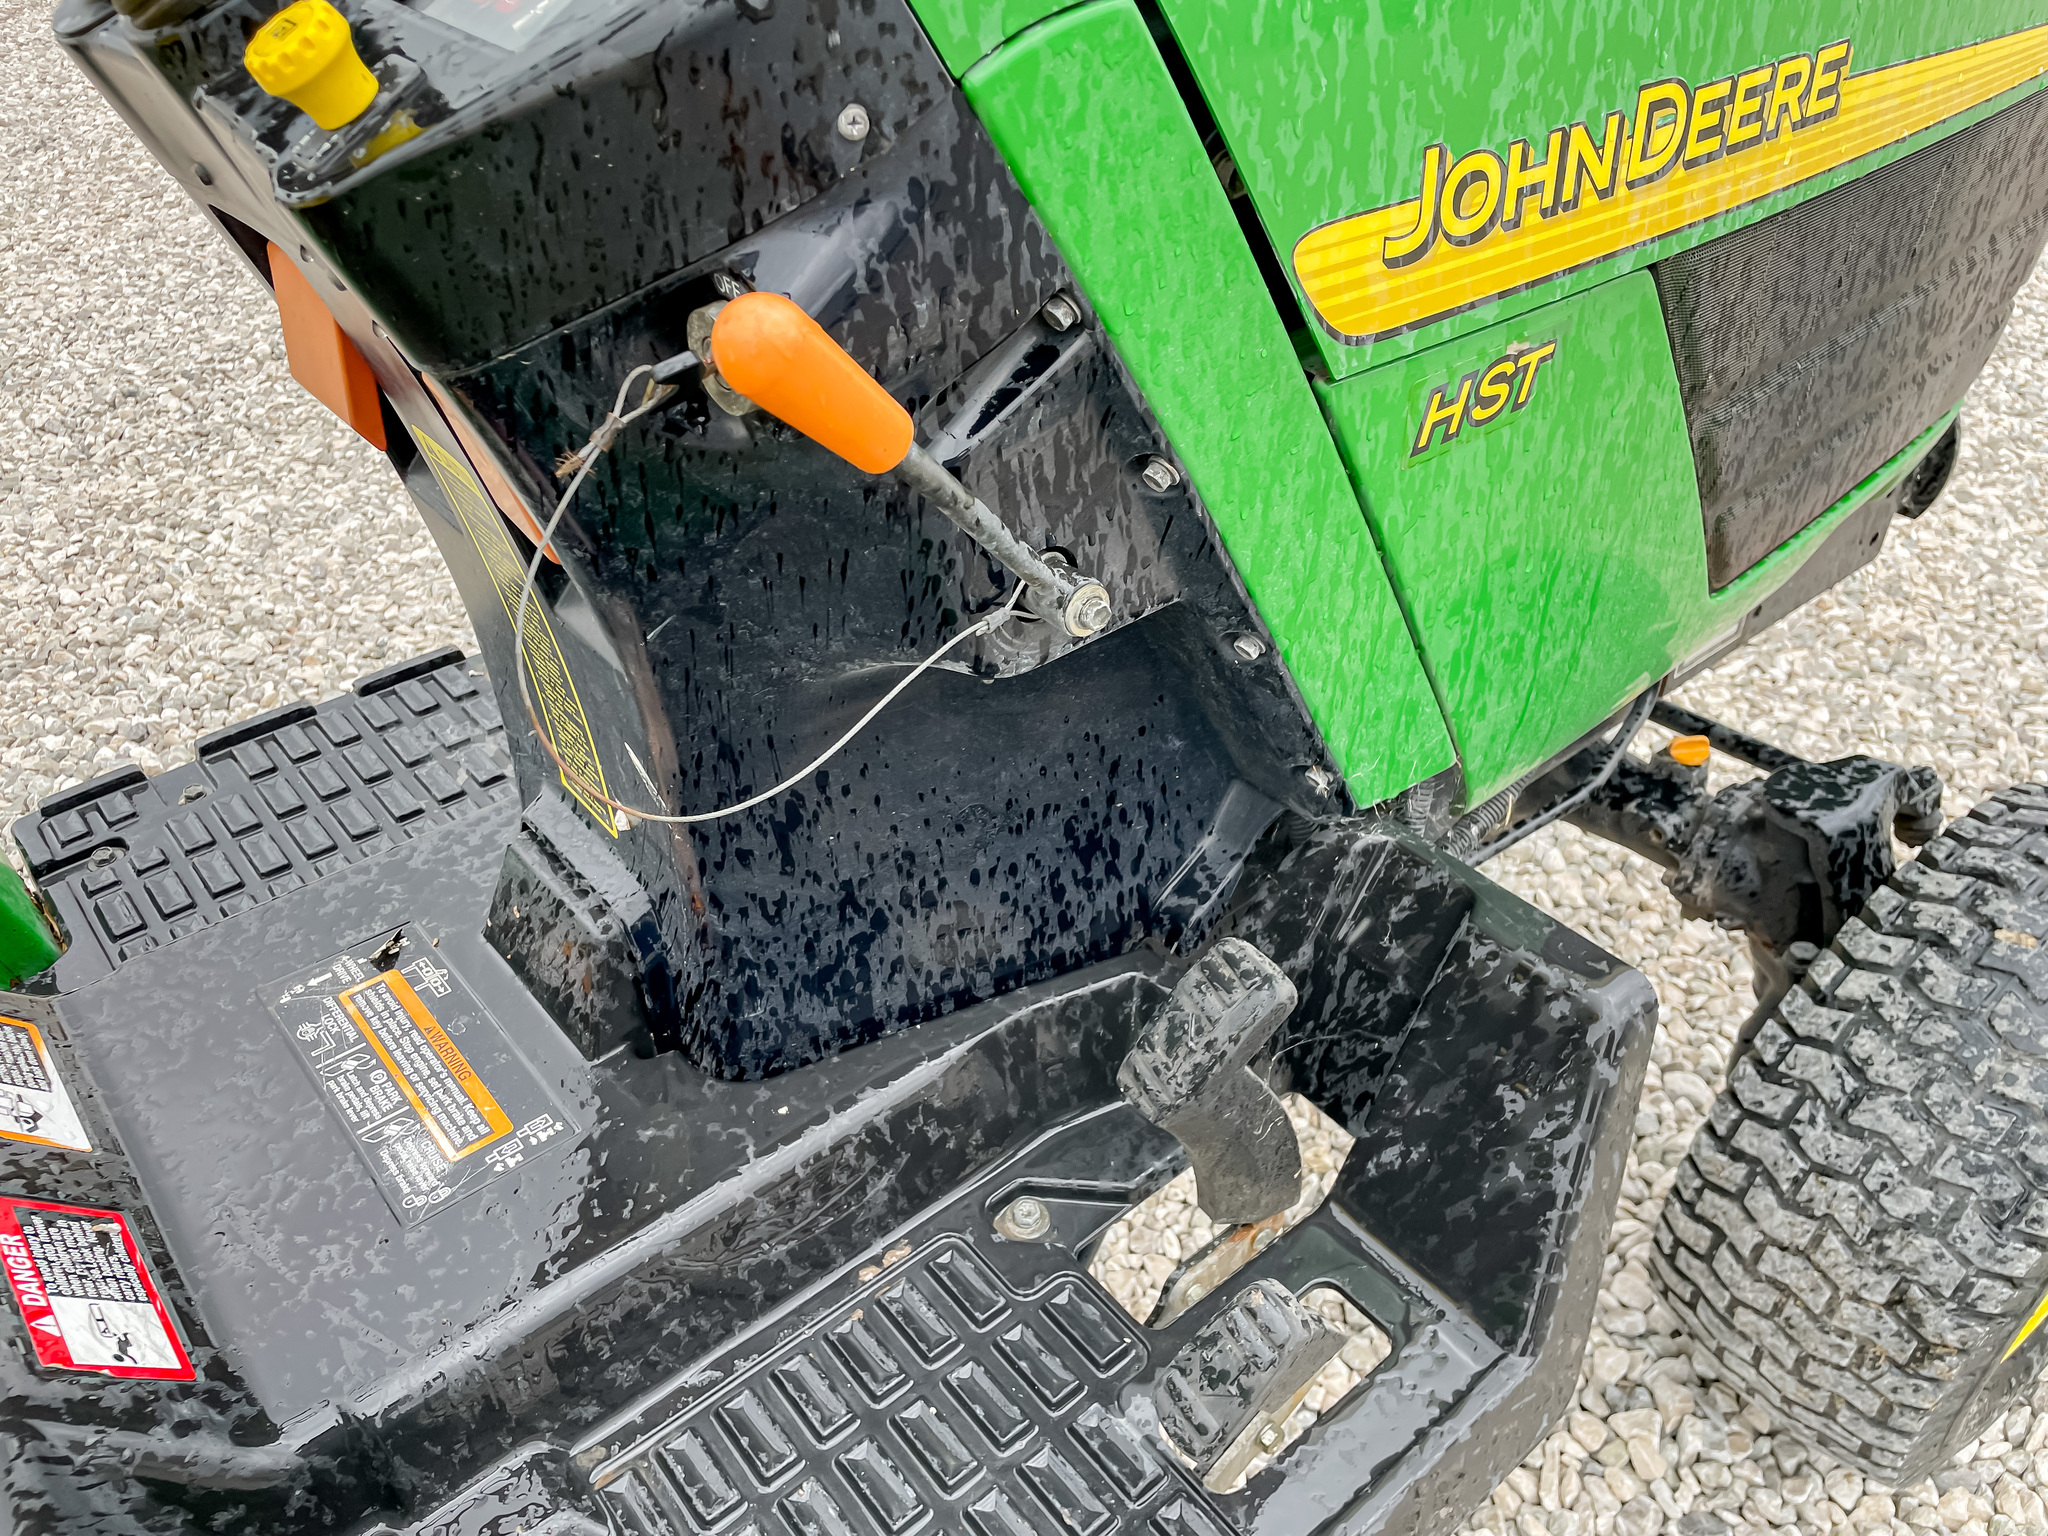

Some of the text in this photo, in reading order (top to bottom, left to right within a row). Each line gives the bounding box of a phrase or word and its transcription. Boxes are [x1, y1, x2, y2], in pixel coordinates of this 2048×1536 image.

[1383, 39, 1853, 270] JOHN DEERE
[713, 273, 741, 298] OFF
[1410, 339, 1558, 458] HST
[332, 964, 351, 983] DRIVE
[321, 1014, 340, 1034] LOCK
[323, 997, 358, 1042] DIFFERENTIAL
[354, 994, 464, 1147] remove key before leaving or servicing machine.
[365, 989, 478, 1141] shields in place. Stop engine, set park brake and
[376, 983, 490, 1135] To avoid injury, read operator's manual. Keep all
[427, 1030, 473, 1081] WARNING
[326, 1080, 359, 1122] park brake lever
[337, 1074, 370, 1120] brake pedals, lift
[346, 1070, 381, 1119] Latch and depress
[370, 1085, 393, 1112] BRAKE
[382, 1082, 402, 1104] PARK
[380, 1149, 411, 1193] Depress brake
[403, 1137, 440, 1186] Depress forward
[421, 1141, 447, 1172] CRUISE
[31, 1215, 50, 1242] mower
[48, 1228, 62, 1240] are
[68, 1221, 88, 1246] behind
[0, 1232, 49, 1307] DANGER
[23, 1226, 59, 1293] To avoid injury to
[67, 1249, 83, 1262] not
[119, 1280, 135, 1300] carry
